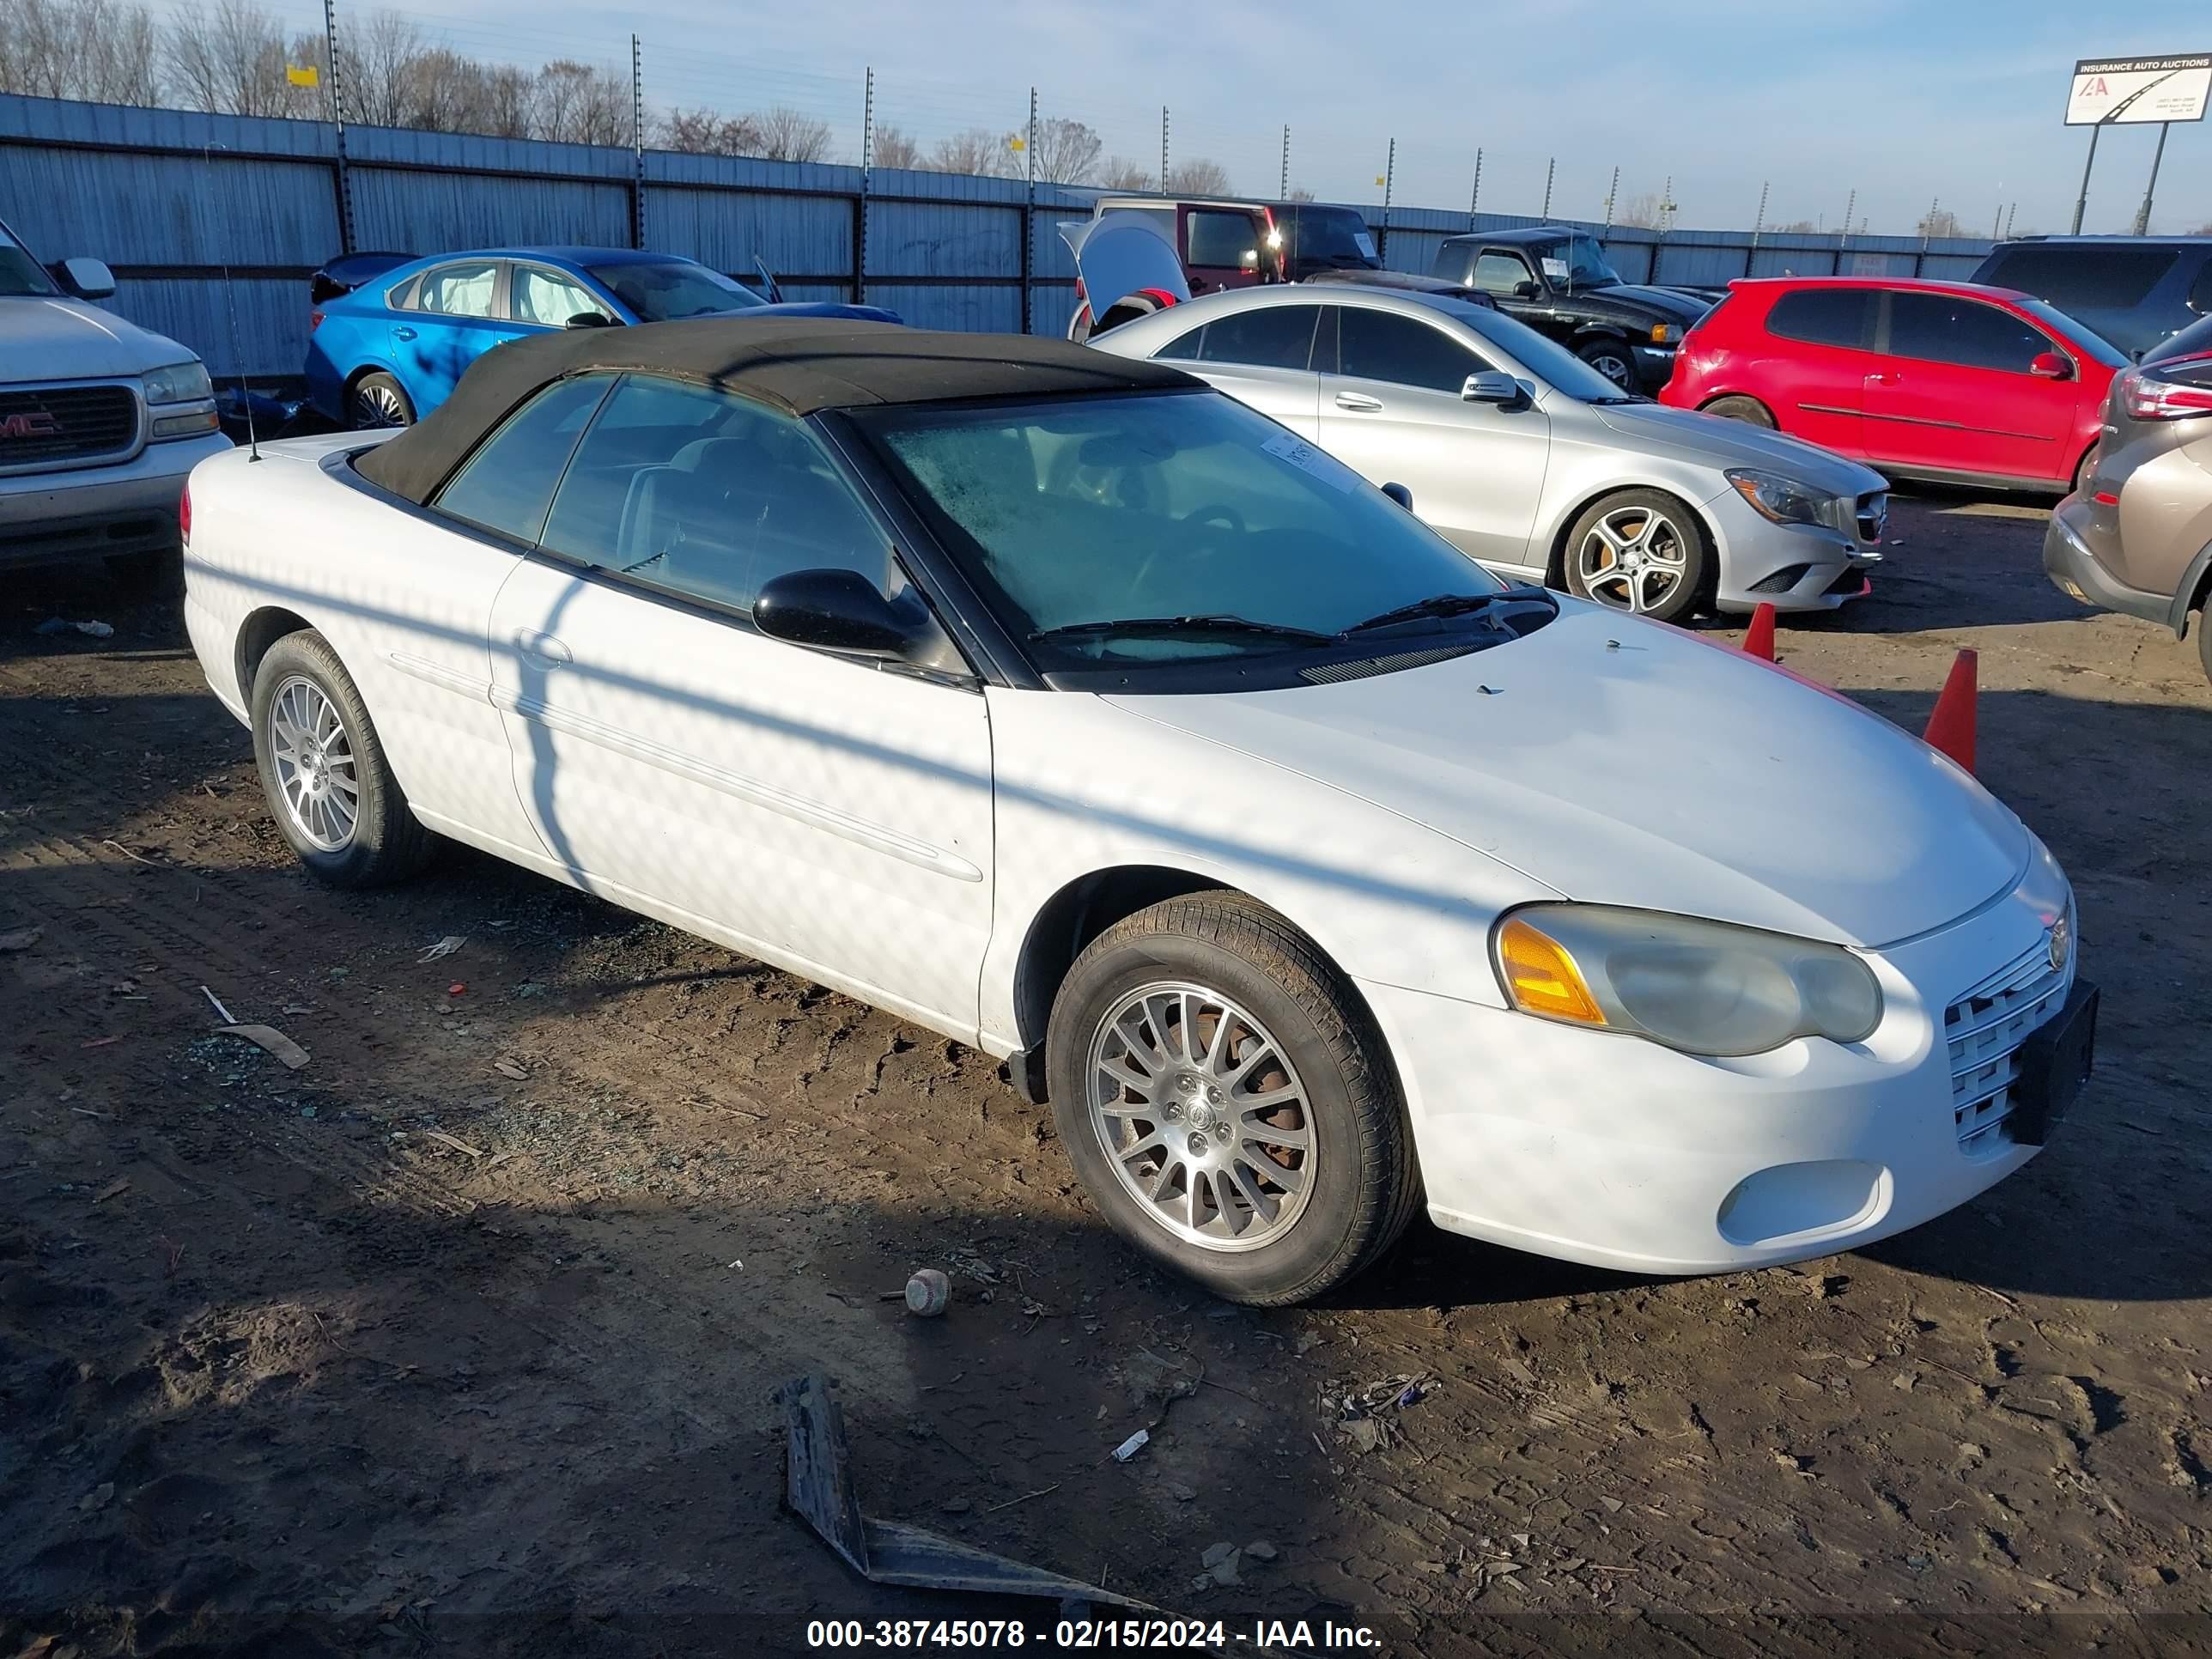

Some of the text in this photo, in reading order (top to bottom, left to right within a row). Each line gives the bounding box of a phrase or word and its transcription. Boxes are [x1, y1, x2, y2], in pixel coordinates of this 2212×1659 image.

[2081, 58, 2209, 73] INSURANCE AUTO AUCTIONS
